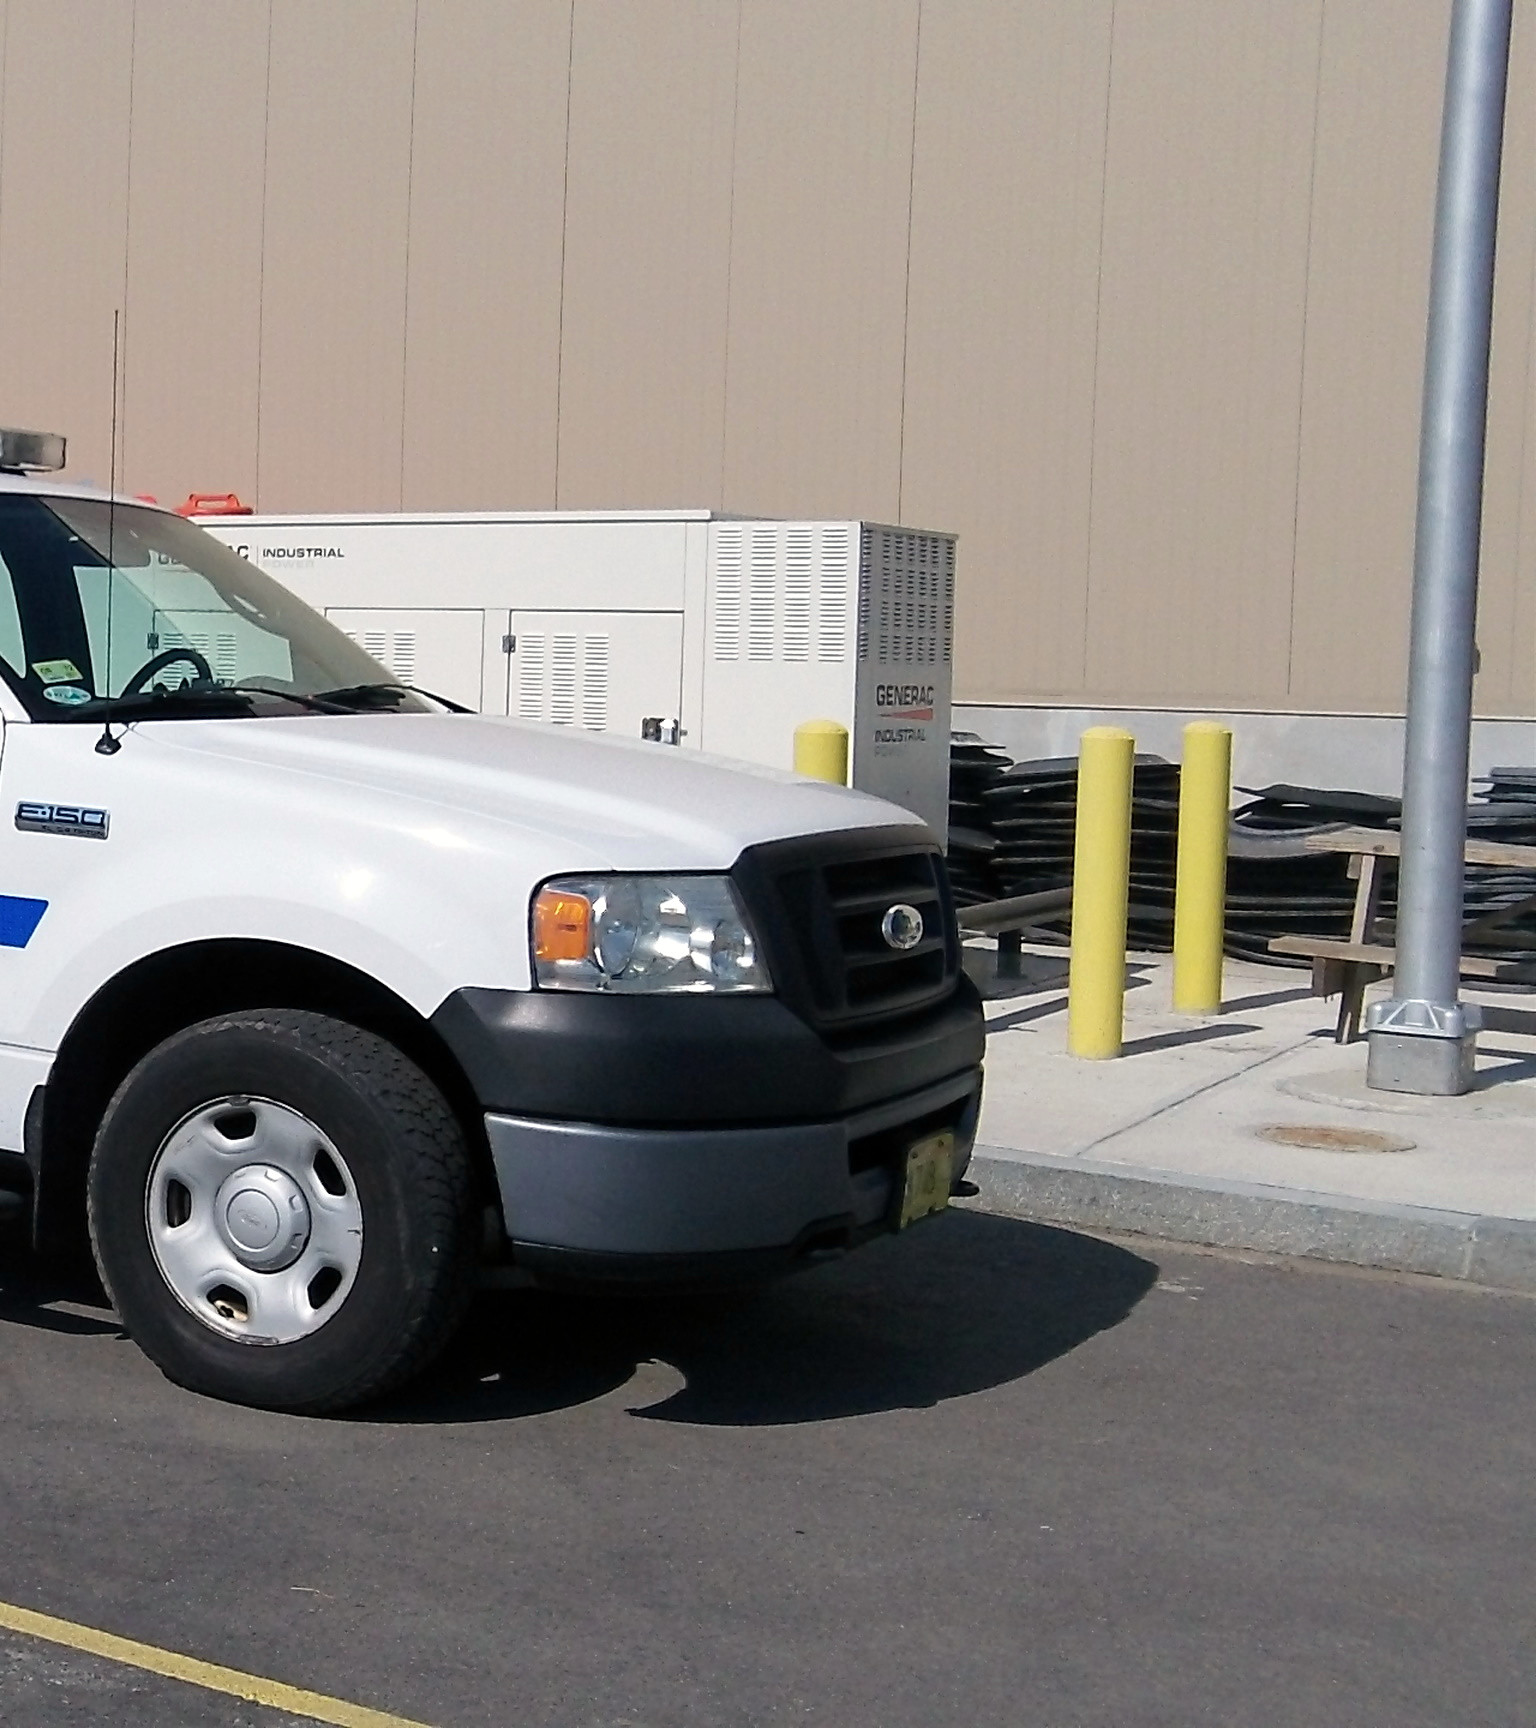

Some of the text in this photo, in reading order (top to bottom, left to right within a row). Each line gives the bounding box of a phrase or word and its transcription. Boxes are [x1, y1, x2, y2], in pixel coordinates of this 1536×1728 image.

[262, 547, 346, 558] INDUSTRIAL
[875, 684, 934, 706] GENERAC
[874, 729, 926, 743] INDUSTRIAL
